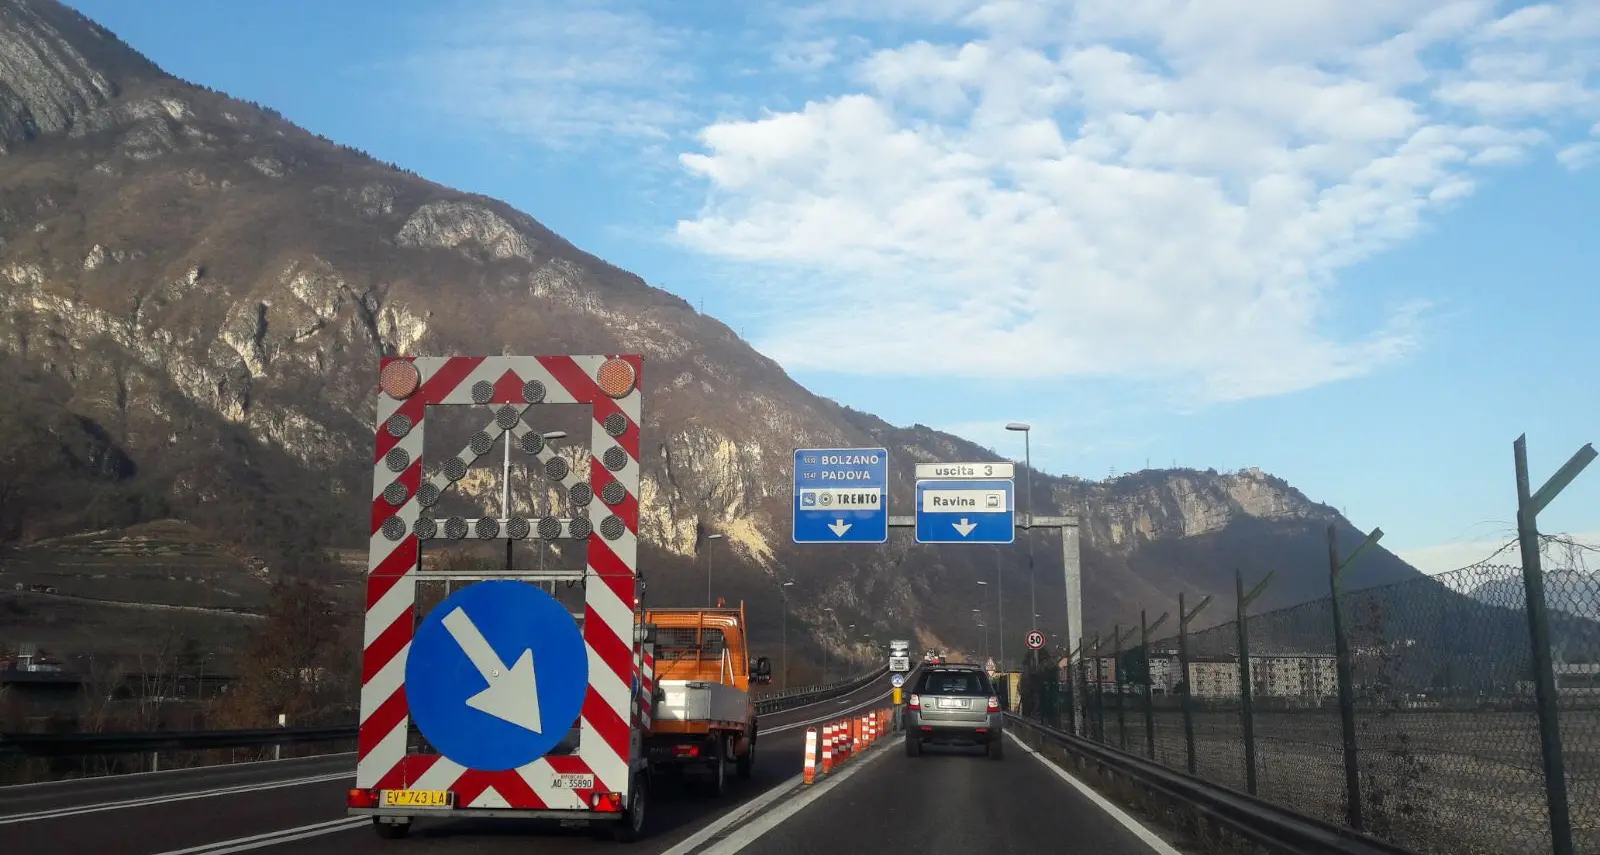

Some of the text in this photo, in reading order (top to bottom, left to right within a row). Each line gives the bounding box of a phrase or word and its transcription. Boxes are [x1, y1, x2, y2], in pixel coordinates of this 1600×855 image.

[821, 455, 879, 465] BOLZANO
[821, 471, 871, 480] PADOVA
[935, 465, 993, 476] uscita 3
[837, 494, 878, 504] TRENTO
[933, 497, 976, 507] Ravina
[1030, 635, 1041, 645] 50
